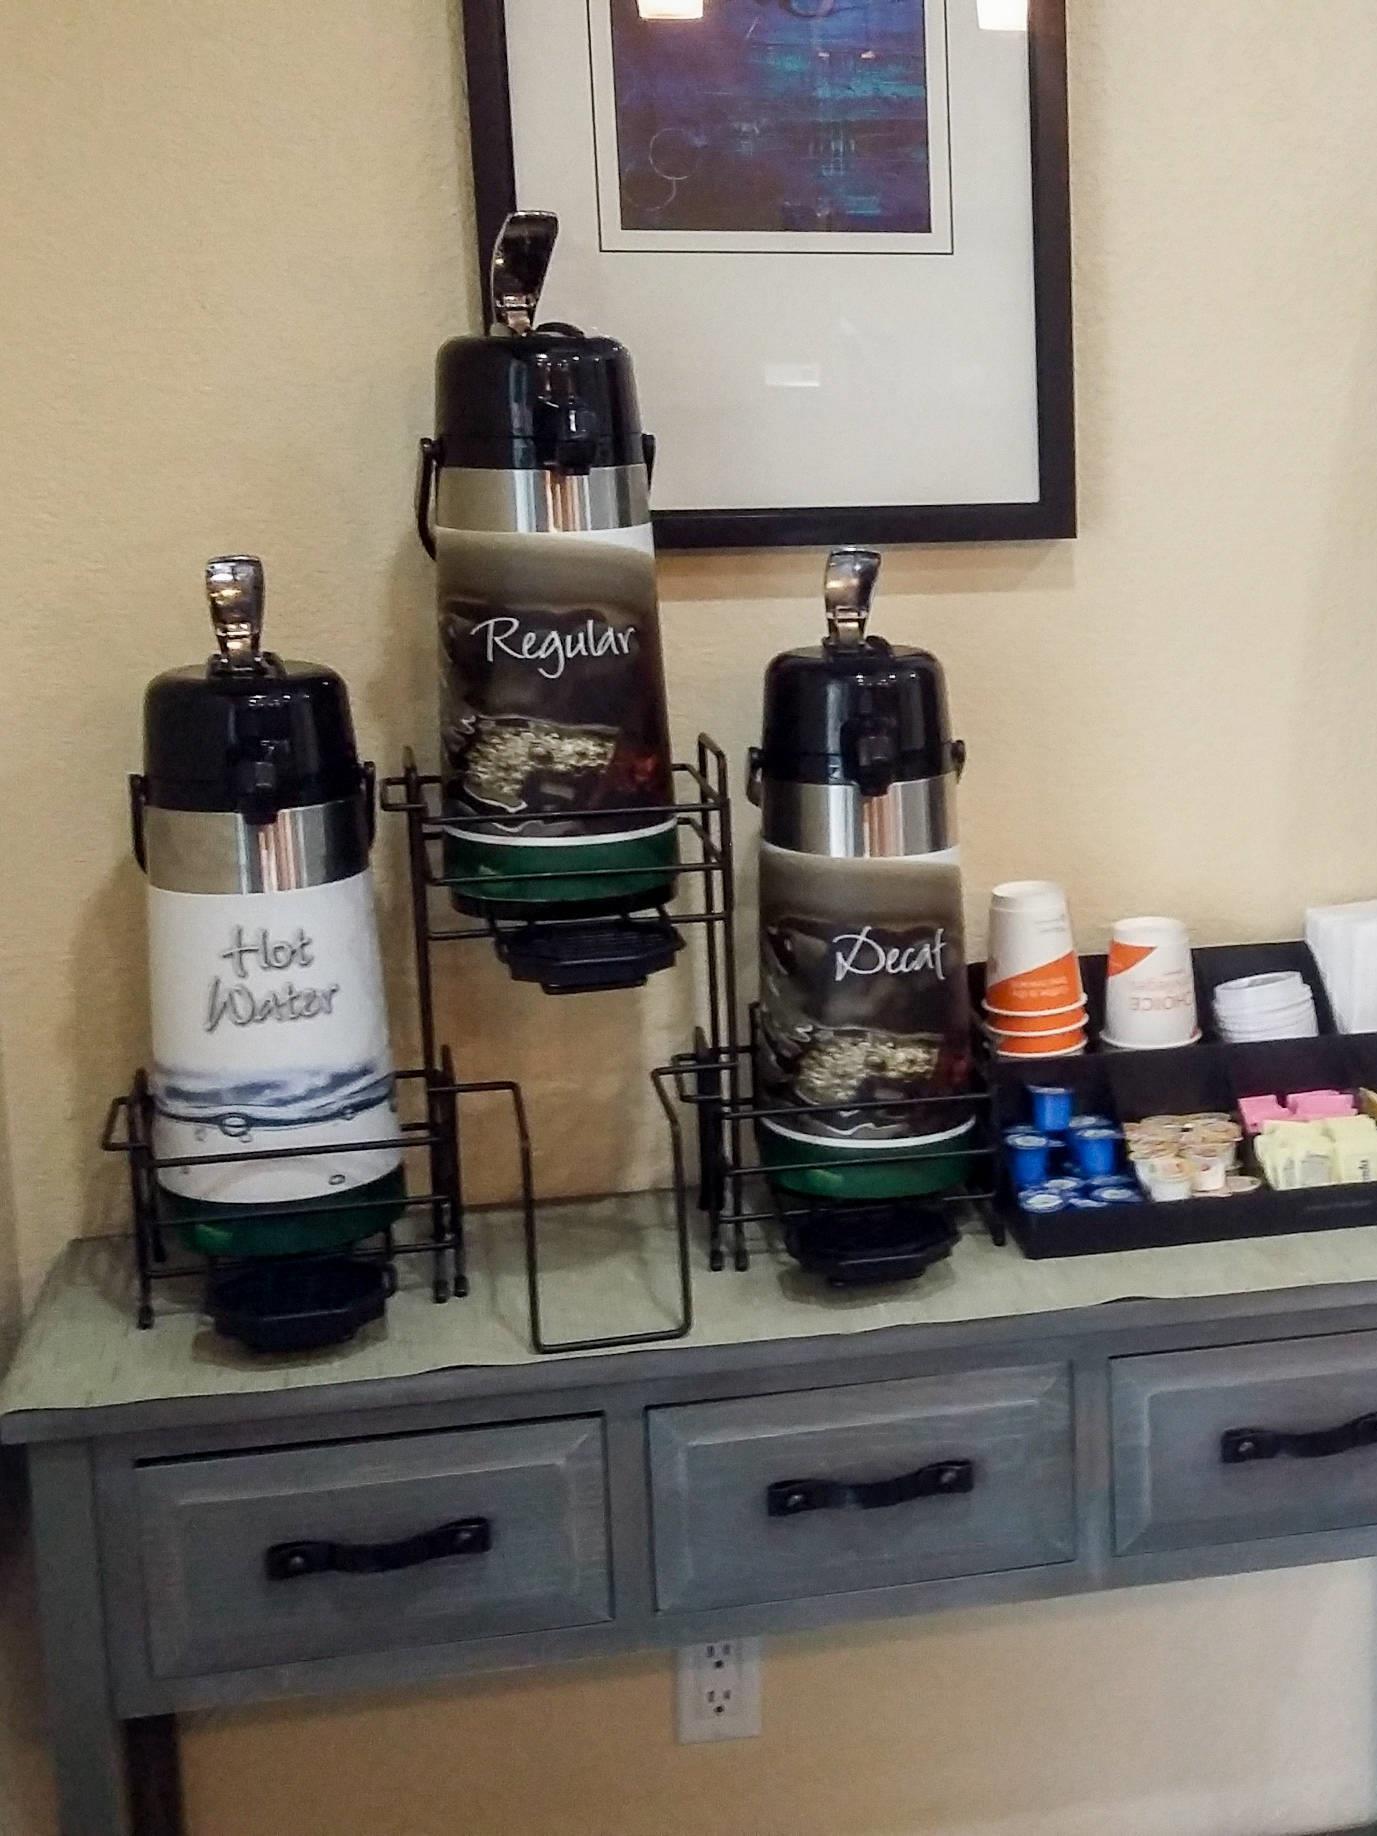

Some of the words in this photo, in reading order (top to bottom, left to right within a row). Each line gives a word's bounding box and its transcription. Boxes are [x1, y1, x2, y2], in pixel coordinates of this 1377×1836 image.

[470, 616, 636, 679] Regular
[222, 924, 315, 978] Hot
[832, 926, 947, 981] Decaf
[204, 976, 341, 1033] Water
